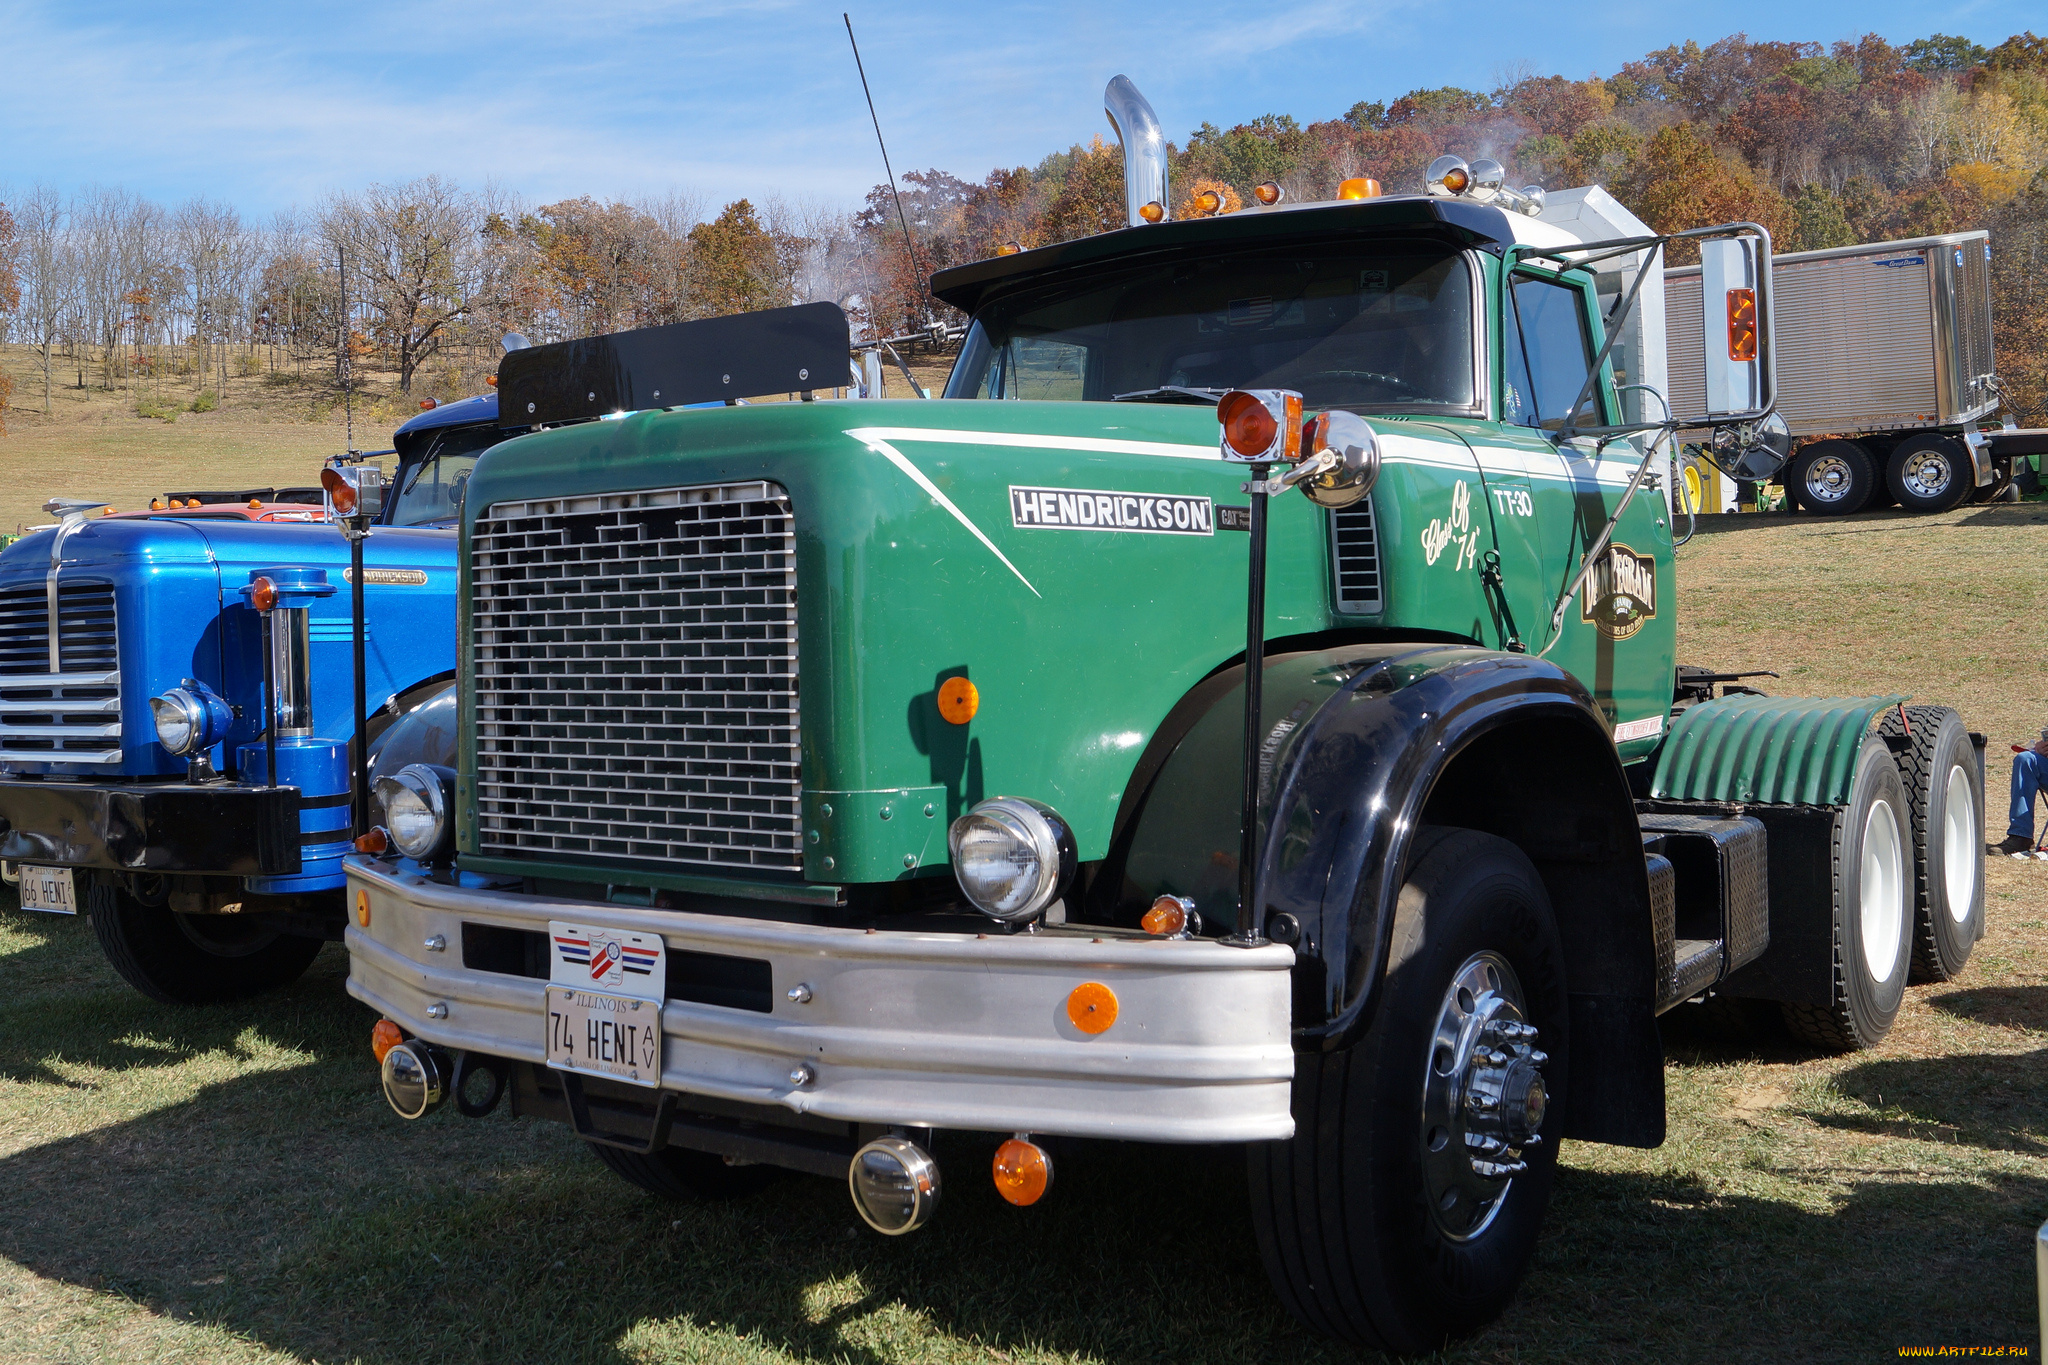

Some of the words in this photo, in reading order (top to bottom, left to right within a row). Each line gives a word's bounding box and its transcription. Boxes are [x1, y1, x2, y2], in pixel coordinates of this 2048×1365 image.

[1018, 491, 1207, 531] HENDRICKSON
[1493, 489, 1533, 517] TT-30
[1221, 509, 1238, 526] CAT
[1421, 516, 1453, 566] Class
[1452, 479, 1471, 533] Of
[348, 570, 423, 583] NDRICKSON
[1585, 557, 1610, 615] DAN
[1609, 548, 1653, 610] PEGRAM
[24, 879, 37, 901] 66
[41, 880, 67, 904] HENI
[576, 994, 627, 1014] ILLINOIS
[550, 1012, 574, 1055] 74
[587, 1018, 637, 1067] HENI
[642, 1025, 655, 1047] A
[642, 1047, 655, 1069] V
[600, 1064, 628, 1076] LINCOLN
